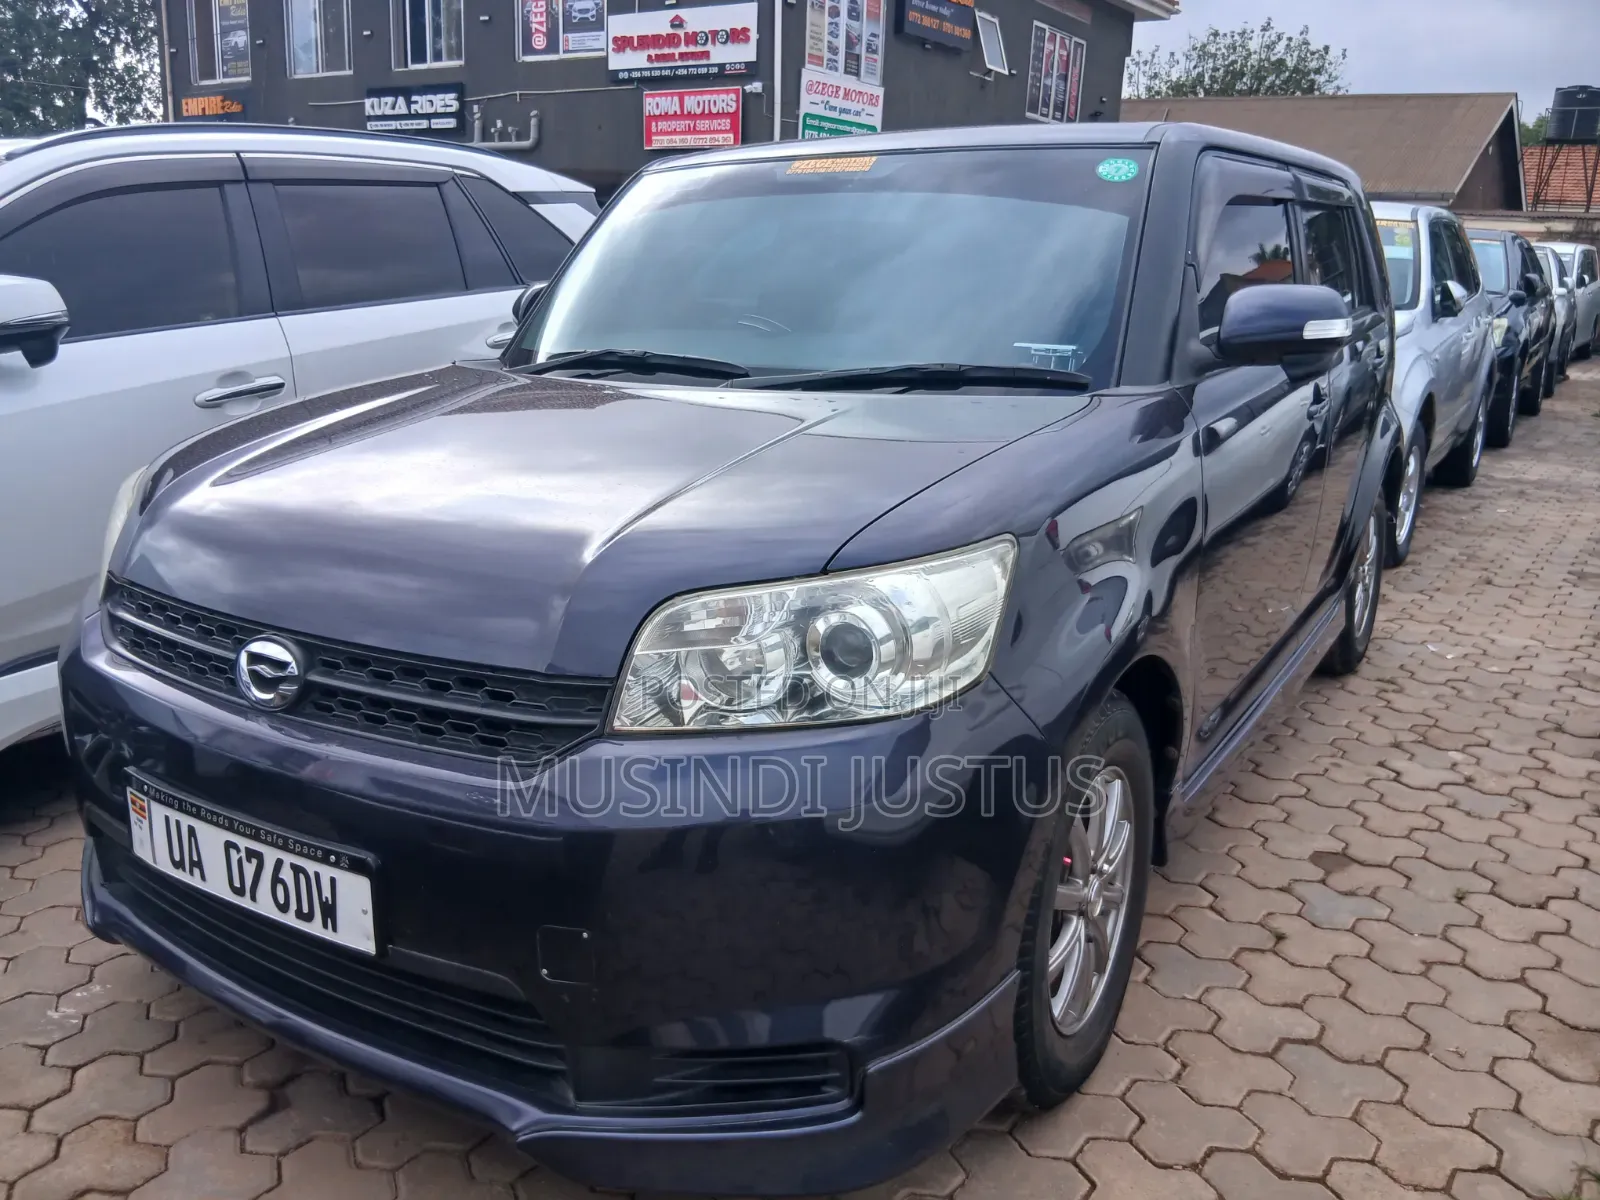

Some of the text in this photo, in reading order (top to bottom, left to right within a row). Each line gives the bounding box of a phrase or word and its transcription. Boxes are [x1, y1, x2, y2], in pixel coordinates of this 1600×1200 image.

[611, 32, 683, 54] SPLENDID
[683, 26, 751, 48] MOTORS
[364, 93, 460, 116] KUZA RIDES
[645, 93, 737, 116] ROMA MOTORS
[805, 80, 880, 107] @ZEGE MOTORS
[182, 96, 225, 116] EMPIRE
[838, 106, 852, 117] your
[651, 118, 731, 133] & PROPERTY SERVICES
[149, 786, 323, 858] Making the Roads Your Safe Space
[164, 814, 338, 933] UA 076DW
